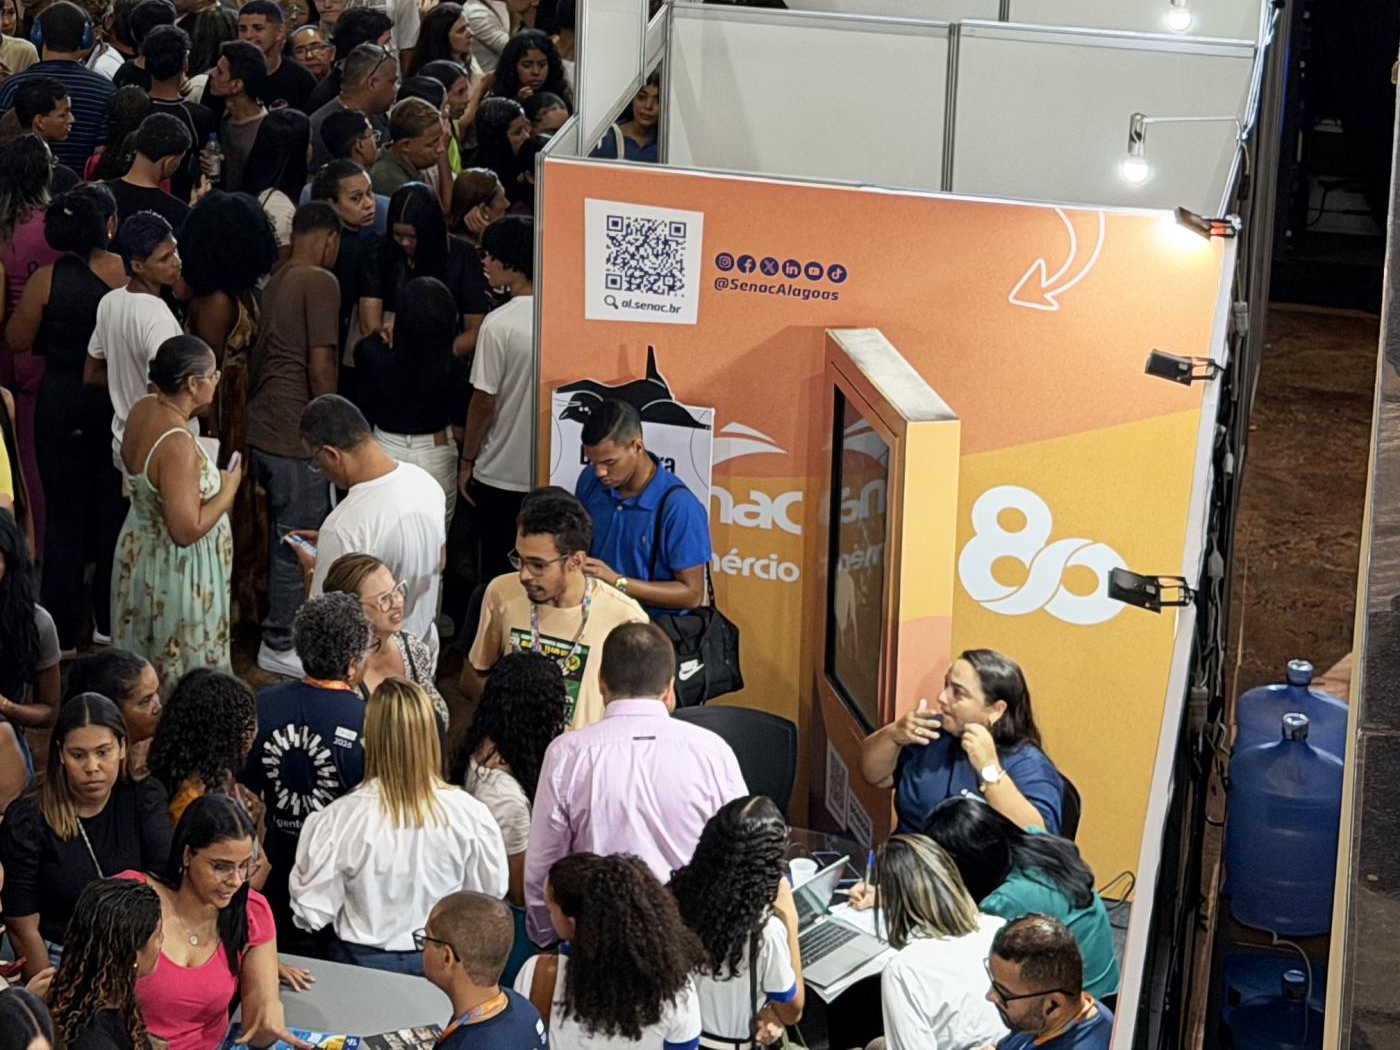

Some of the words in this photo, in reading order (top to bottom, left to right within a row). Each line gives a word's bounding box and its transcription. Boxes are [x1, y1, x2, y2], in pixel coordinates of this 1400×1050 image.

[714, 276, 840, 301] @SenacAlagoas
[621, 298, 681, 314] al.senac.br
[711, 485, 804, 535] nac
